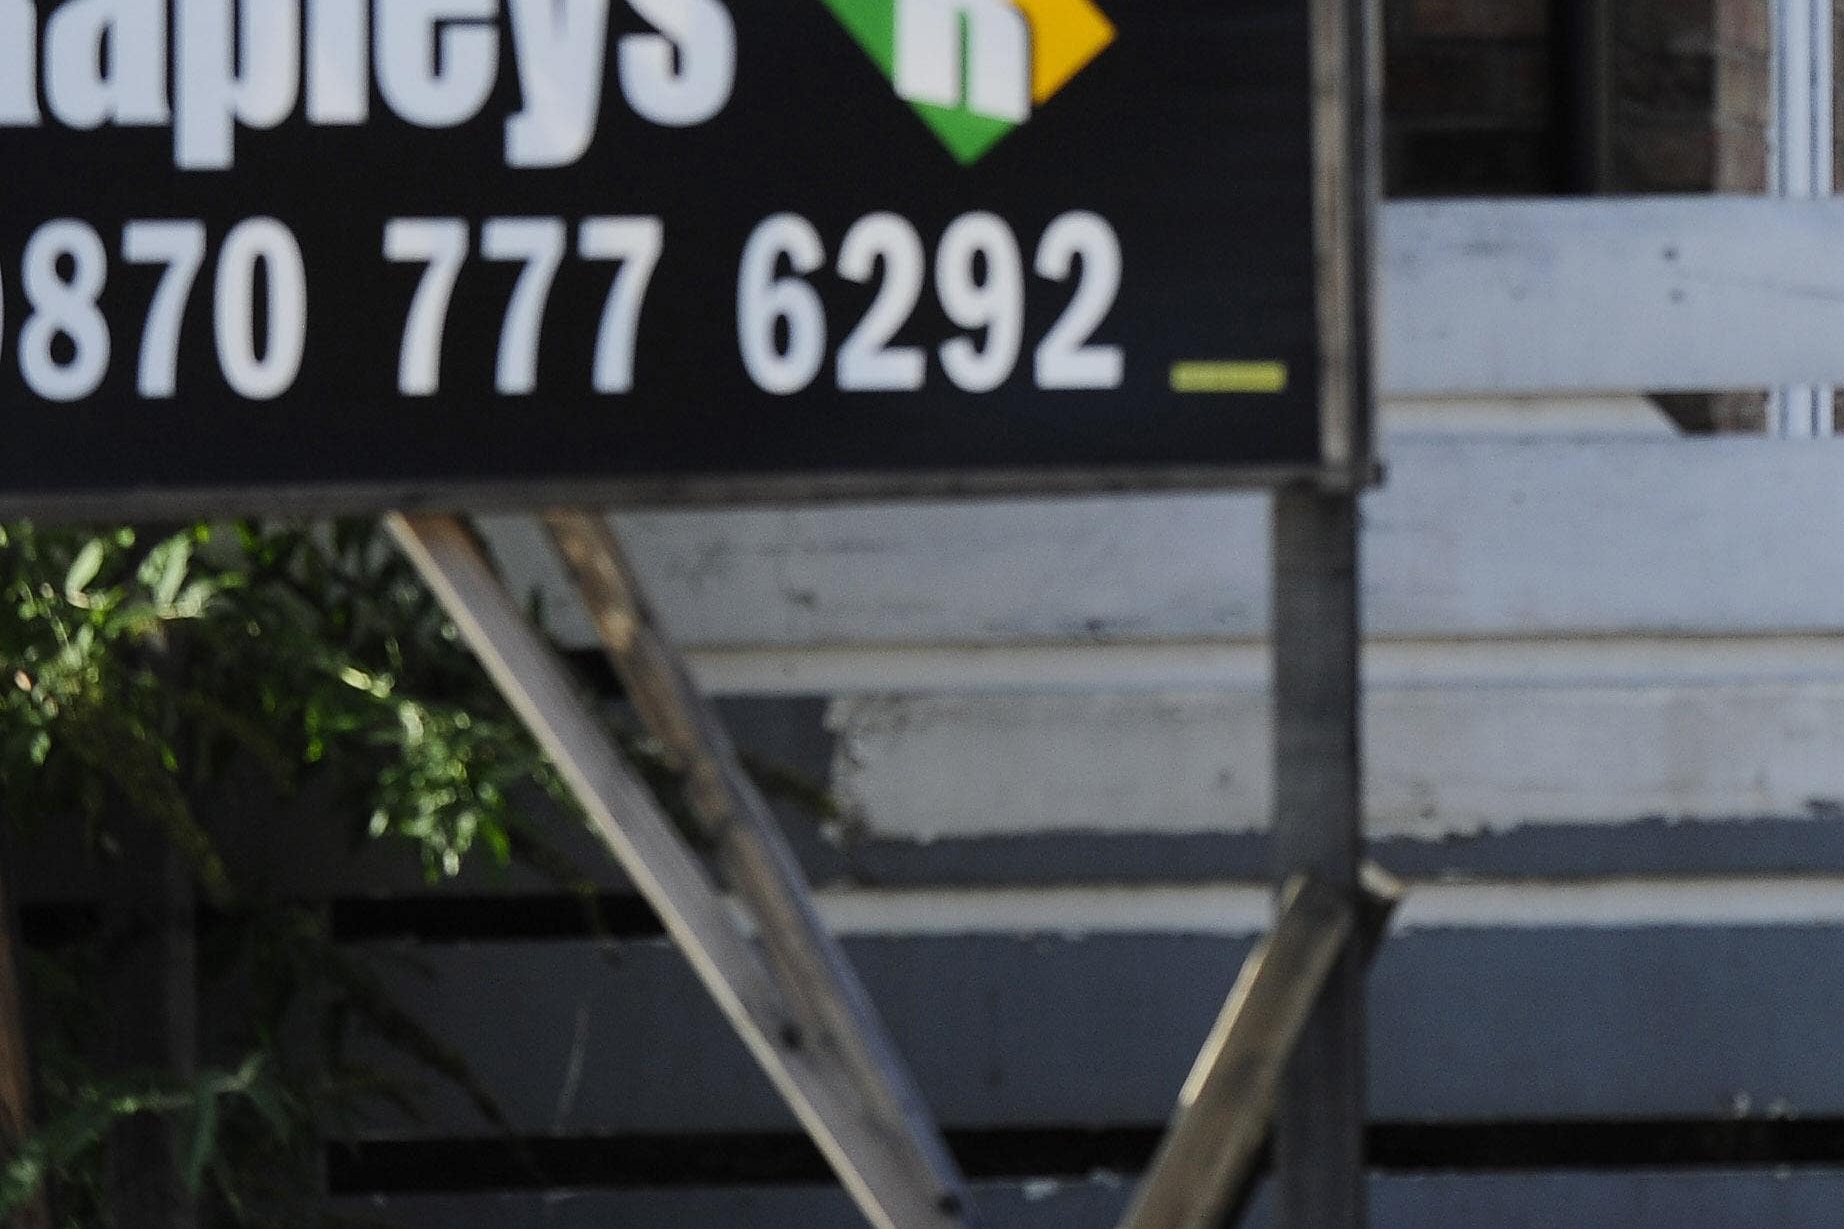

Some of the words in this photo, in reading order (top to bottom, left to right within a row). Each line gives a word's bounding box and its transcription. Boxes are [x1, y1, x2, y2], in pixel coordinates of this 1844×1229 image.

[0, 216, 308, 402] 870
[382, 215, 664, 396] 777
[735, 210, 1125, 395] 6292
